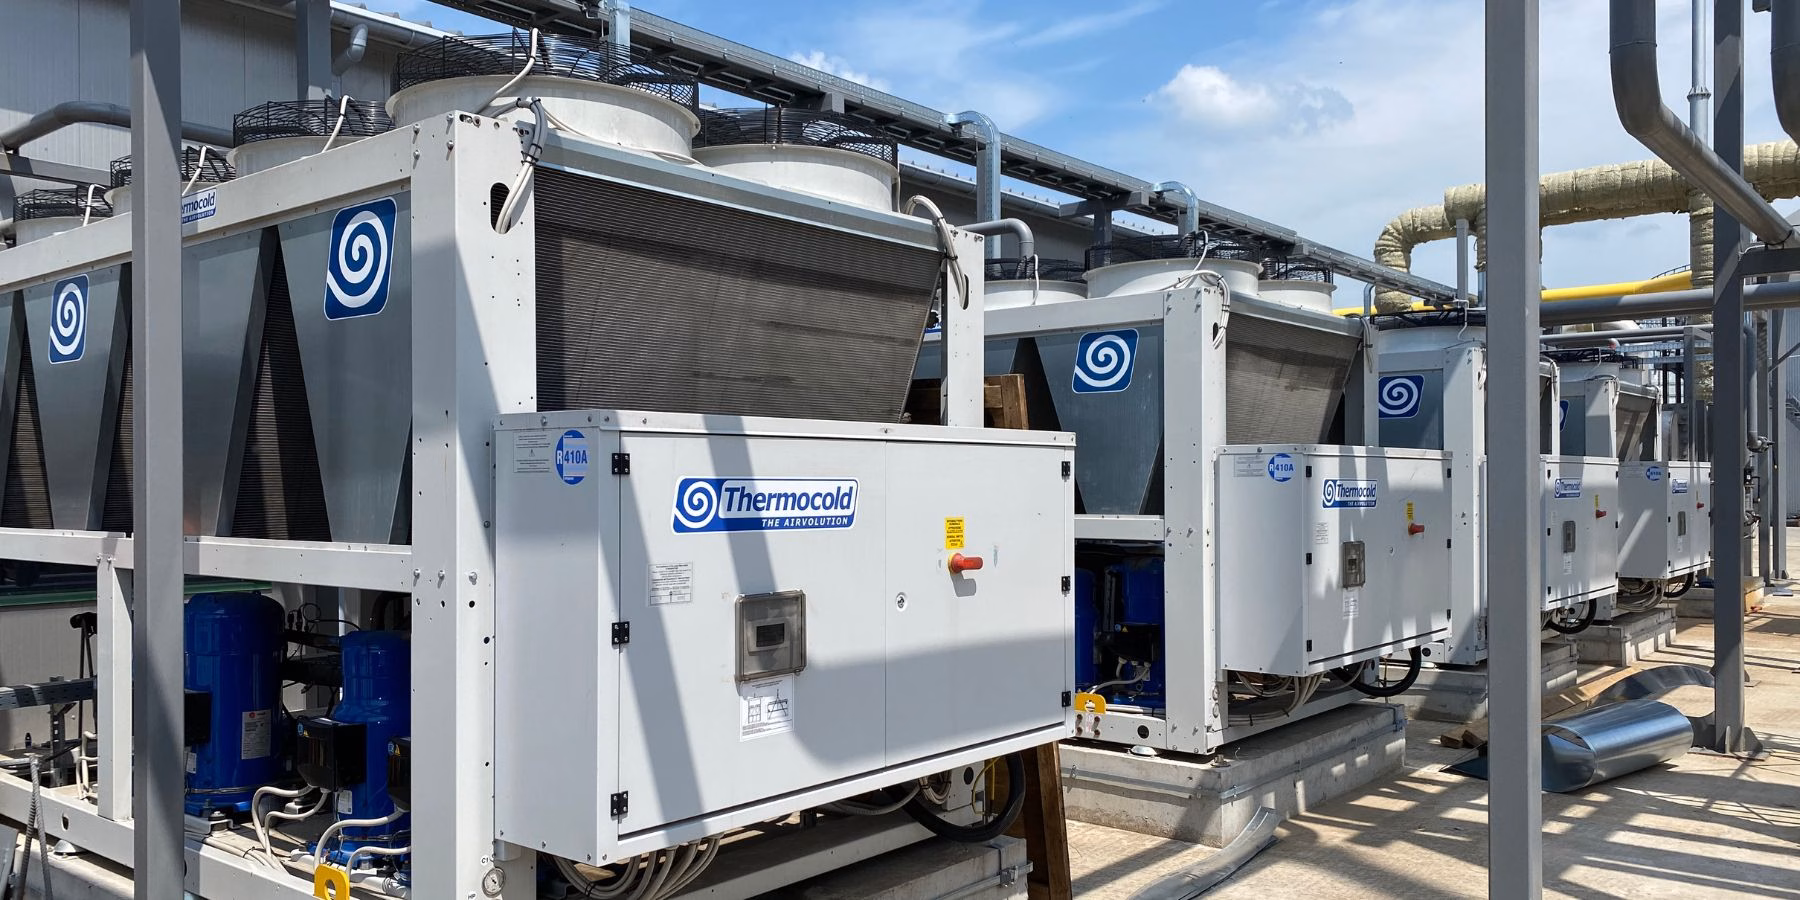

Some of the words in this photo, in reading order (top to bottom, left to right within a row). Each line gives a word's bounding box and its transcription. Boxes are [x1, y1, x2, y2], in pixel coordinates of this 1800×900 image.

[182, 192, 216, 214] rmocold
[724, 486, 853, 512] Thermocold
[1336, 484, 1377, 498] Thermocold
[762, 518, 780, 527] THE
[784, 517, 849, 527] AIRVOLUTION
